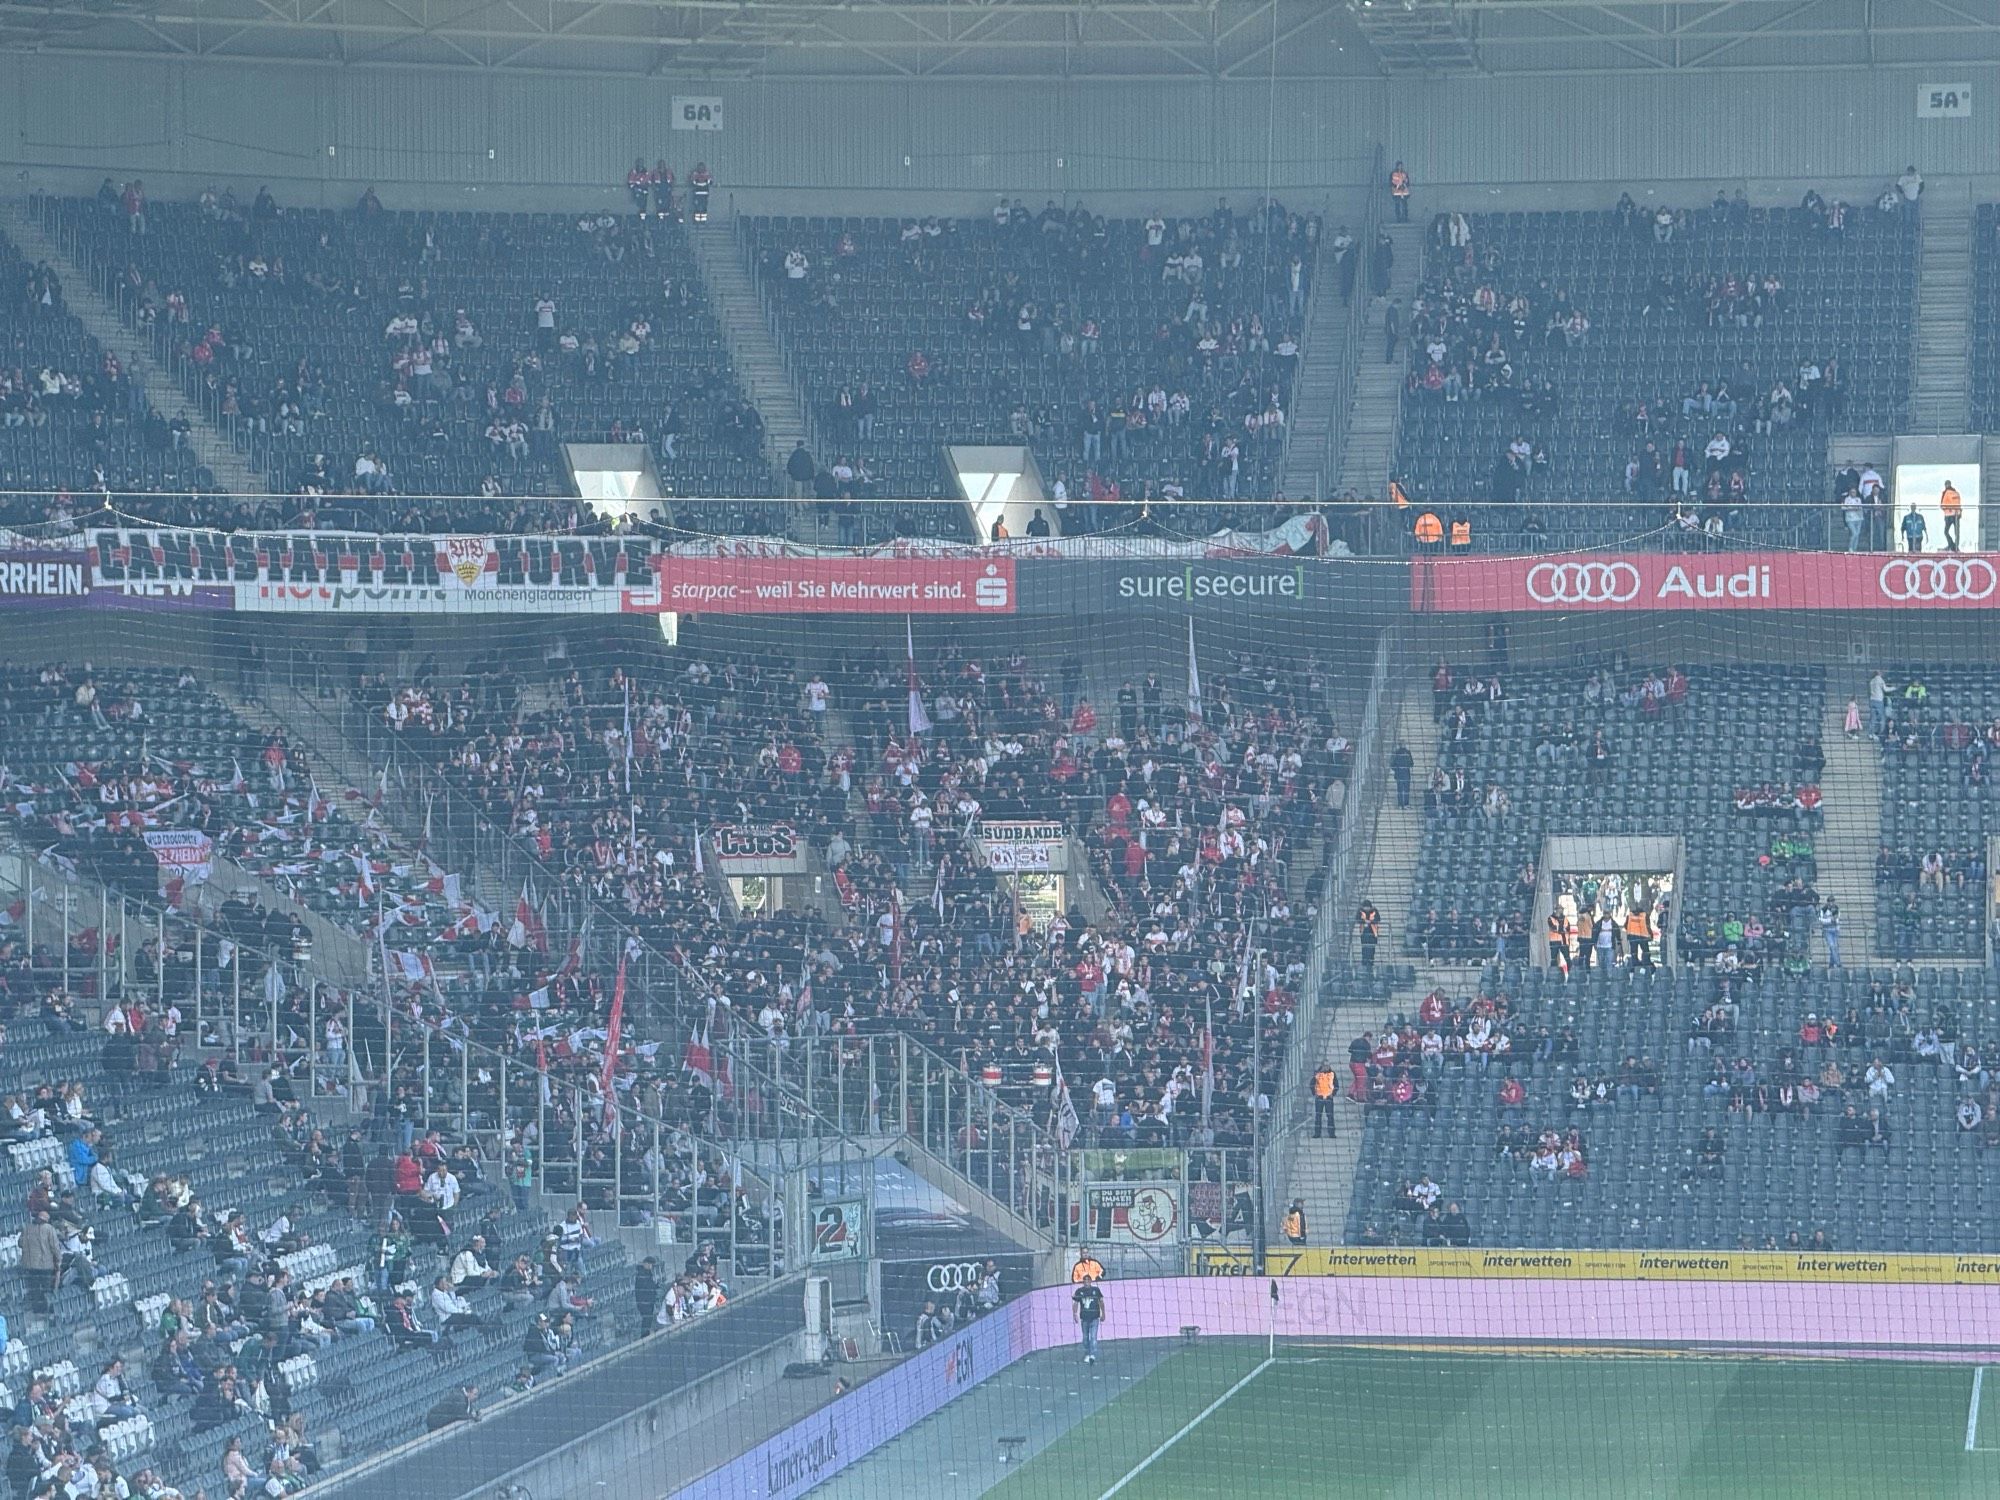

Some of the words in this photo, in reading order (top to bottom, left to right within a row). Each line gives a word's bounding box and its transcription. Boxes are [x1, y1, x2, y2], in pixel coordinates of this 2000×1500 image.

[672, 582, 738, 602] starpac
[756, 580, 792, 598] weil
[798, 580, 825, 598] Sie
[831, 580, 919, 598] Mehrwert
[924, 580, 966, 598] sind.
[1657, 565, 1770, 598] Audi
[984, 825, 1062, 840] SÜDBANDE
[1329, 1249, 1417, 1266] interwetten
[1483, 1250, 1572, 1267] interwetten
[1639, 1252, 1729, 1270] interwetten
[1797, 1255, 1887, 1271] interwetten
